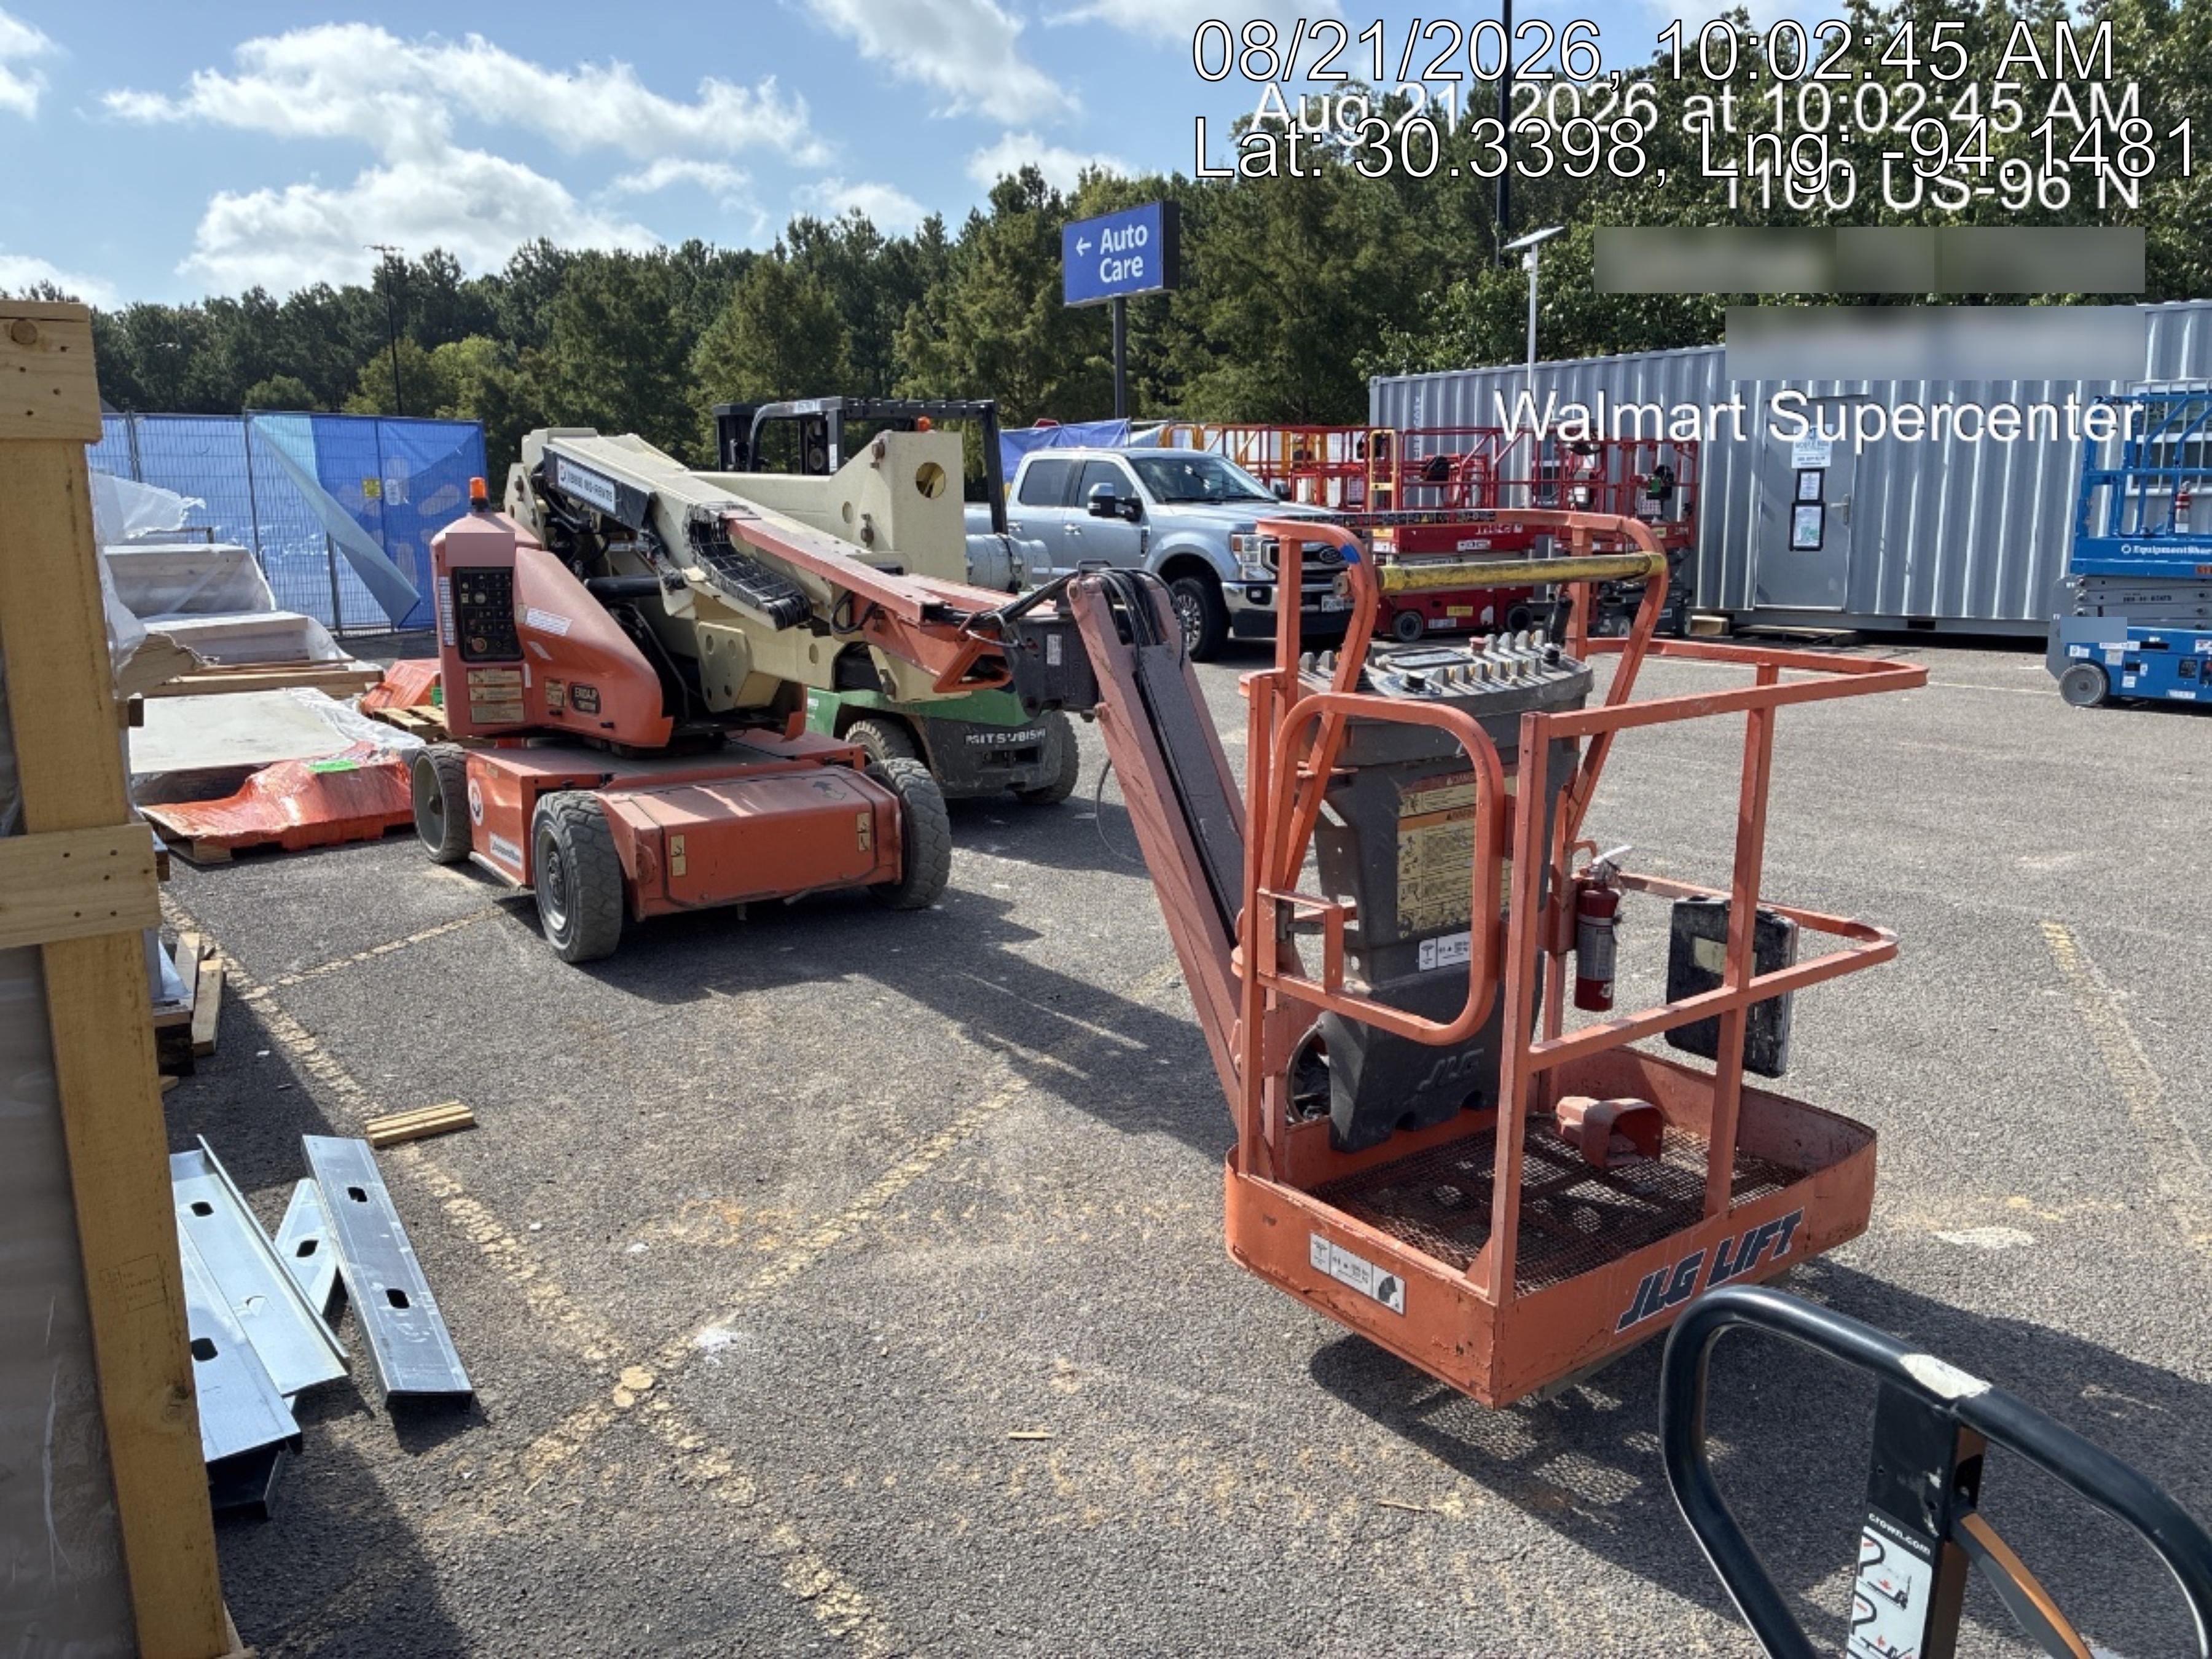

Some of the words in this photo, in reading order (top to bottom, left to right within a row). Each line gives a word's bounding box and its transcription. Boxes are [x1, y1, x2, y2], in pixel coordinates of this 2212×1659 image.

[1100, 224, 1148, 255] Auto
[1100, 256, 1143, 283] Care
[2133, 544, 2212, 556] EquipmentShar
[1615, 1248, 1707, 1333] JLG
[1704, 1206, 1805, 1291] LIFT
[1869, 1513, 1931, 1557] crown.com
